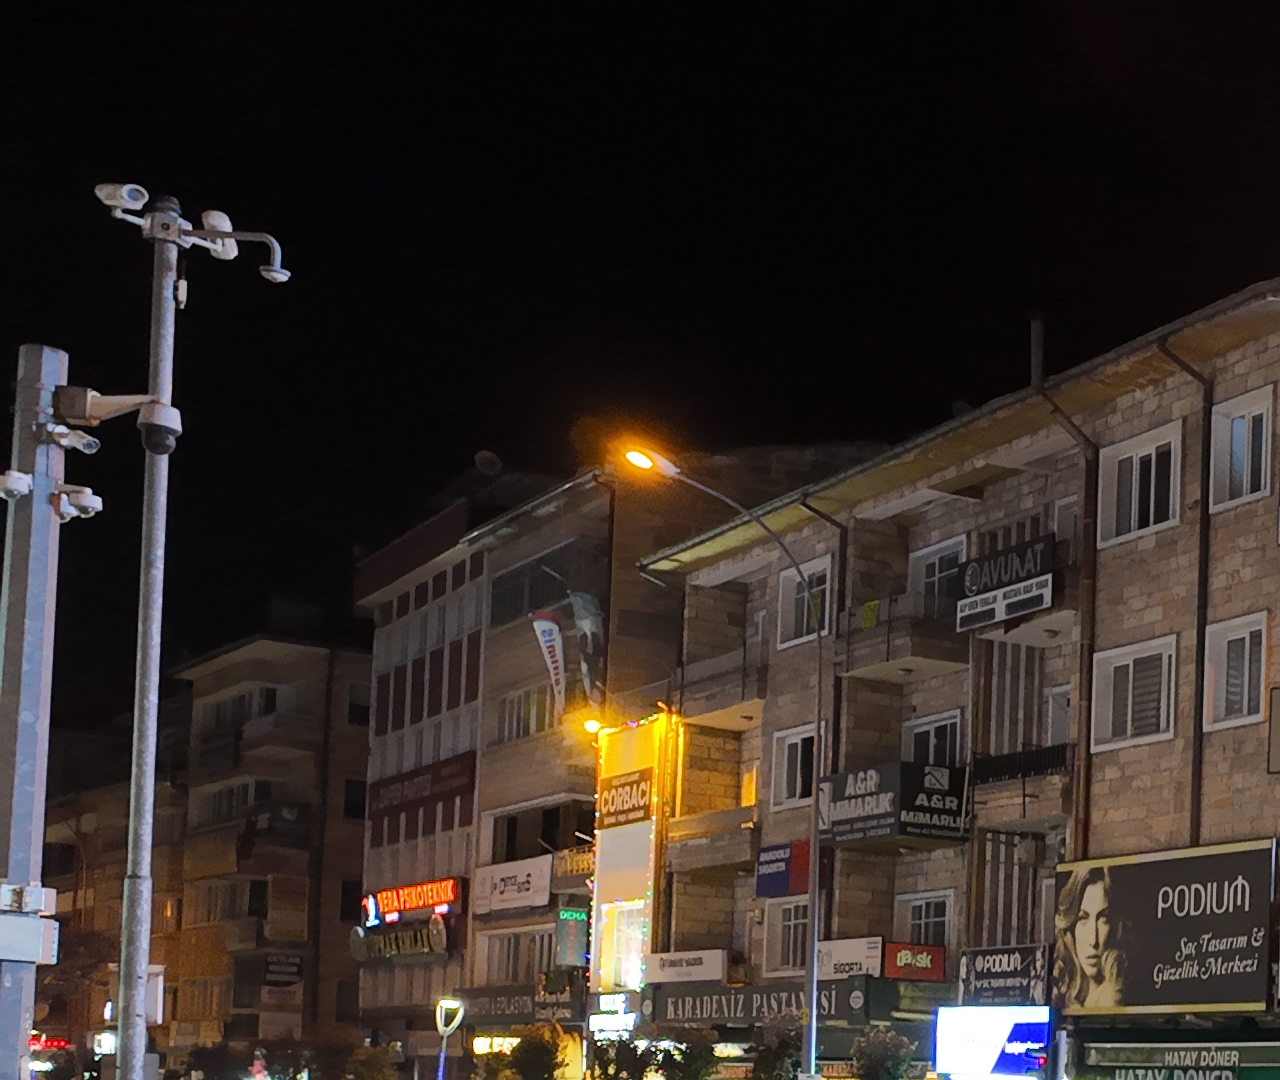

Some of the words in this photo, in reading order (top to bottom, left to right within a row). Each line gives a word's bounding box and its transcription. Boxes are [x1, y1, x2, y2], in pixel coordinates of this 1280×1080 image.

[980, 543, 1045, 591] AVUKAT
[845, 769, 880, 797] A&R
[915, 793, 958, 810] A&R
[1157, 875, 1250, 918] PODIUM
[1175, 937, 1197, 962] Saç
[1200, 931, 1248, 952] Tasarım
[1251, 927, 1265, 947] &
[1153, 959, 1199, 989] Güzellik
[1200, 953, 1258, 979] Merkezi
[667, 990, 744, 1019] KARADENİZ
[1165, 1051, 1198, 1066] HATAY
